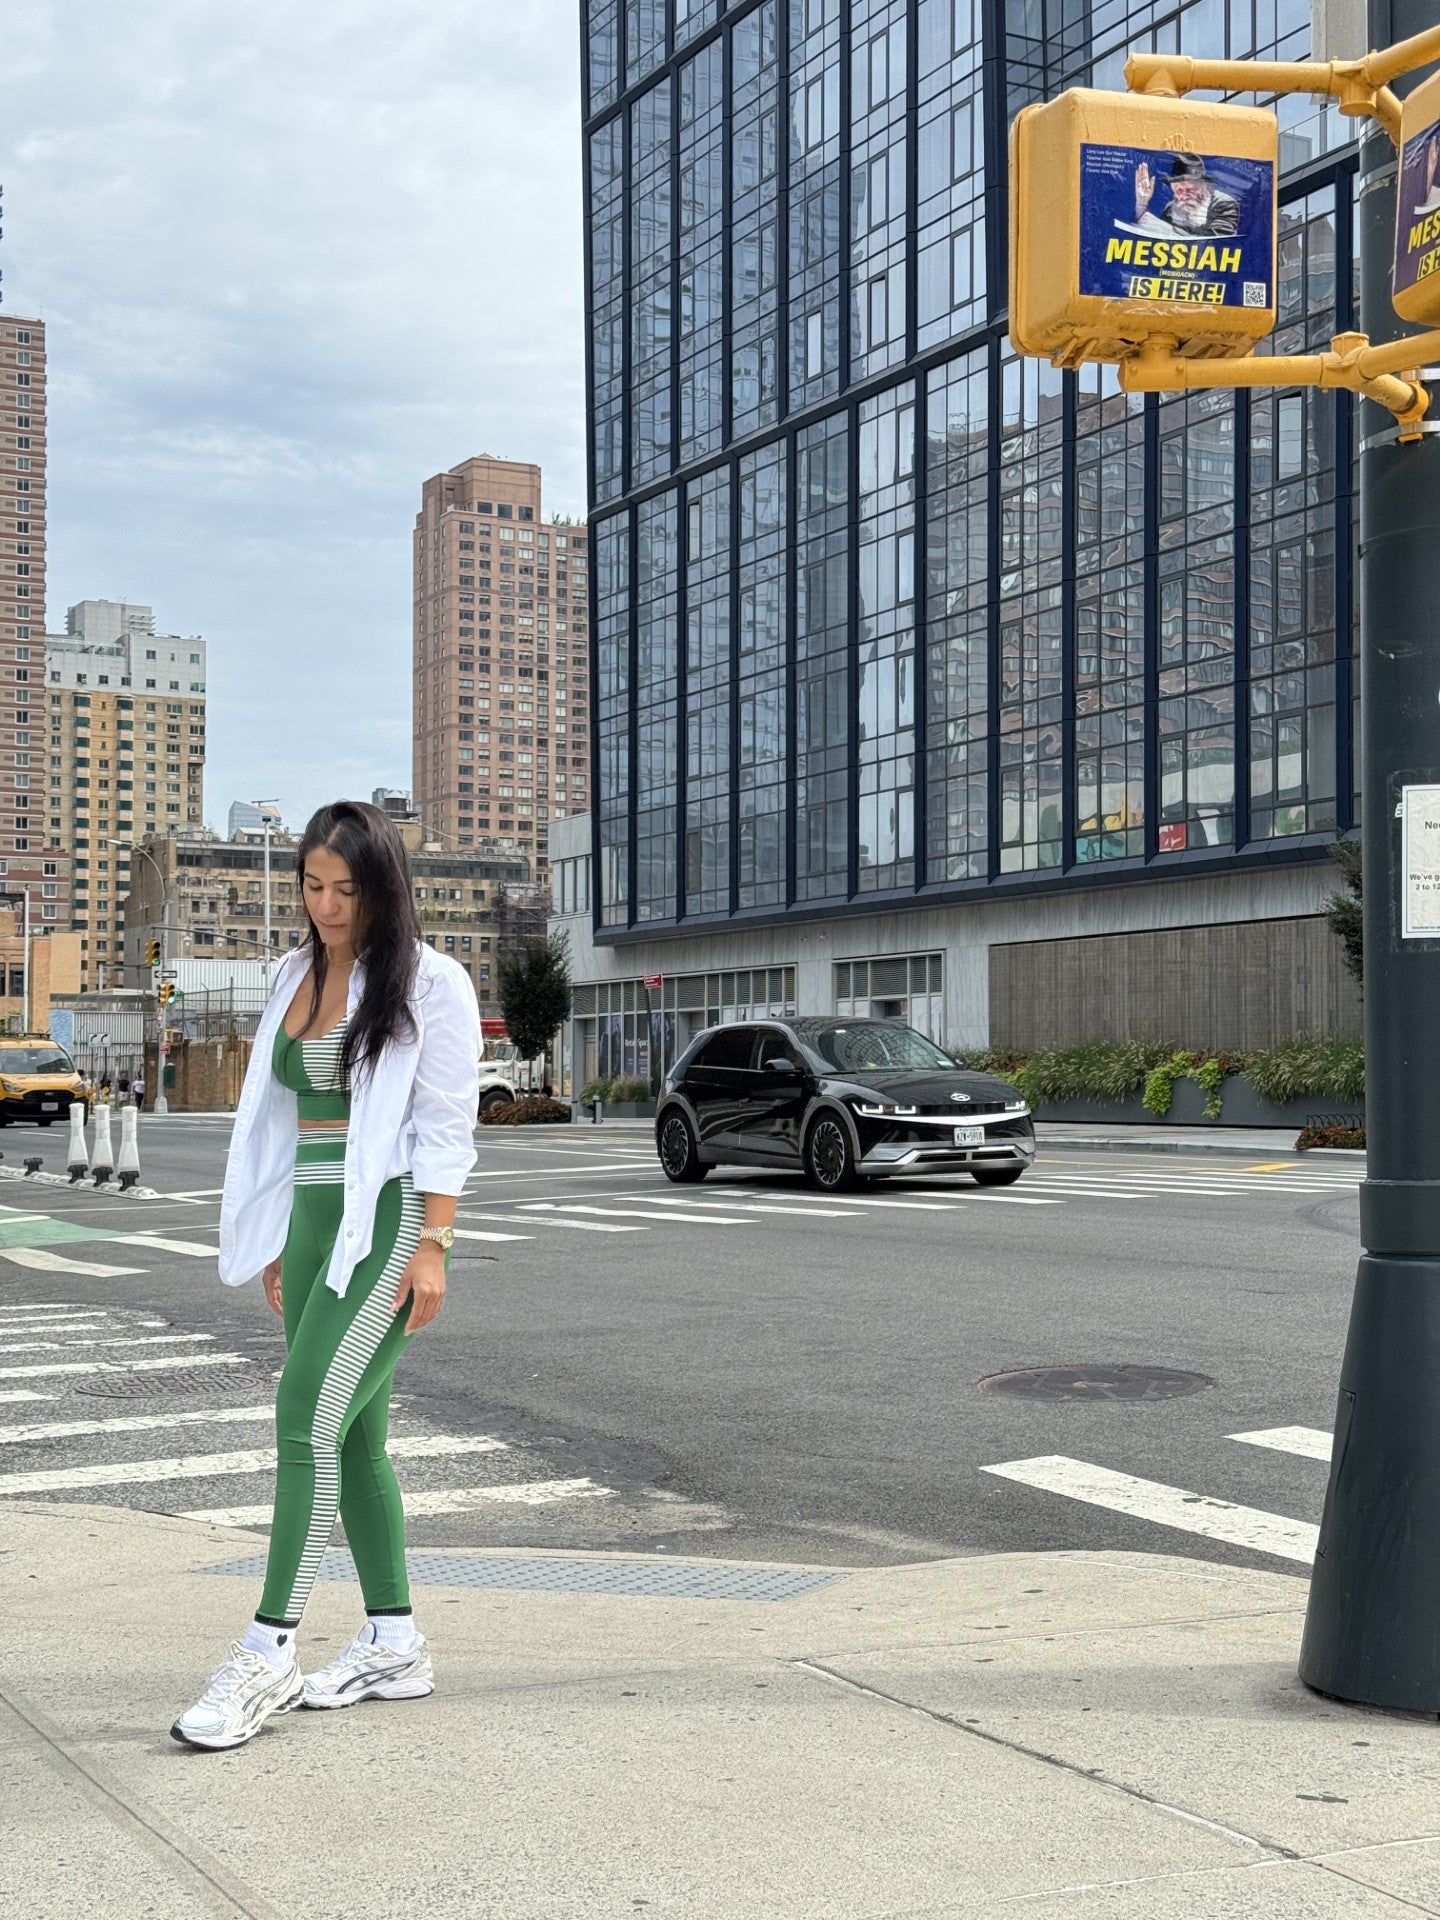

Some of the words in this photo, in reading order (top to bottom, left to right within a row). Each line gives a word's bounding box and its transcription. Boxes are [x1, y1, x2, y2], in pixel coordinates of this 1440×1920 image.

[1407, 209, 1440, 254] MES
[1105, 238, 1242, 273] MESSIAH
[1418, 254, 1431, 278] IS
[1159, 269, 1196, 280] (MOSHIACH)
[1131, 277, 1152, 297] IS
[1157, 280, 1222, 303] HERE!
[1425, 820, 1440, 829] Ne
